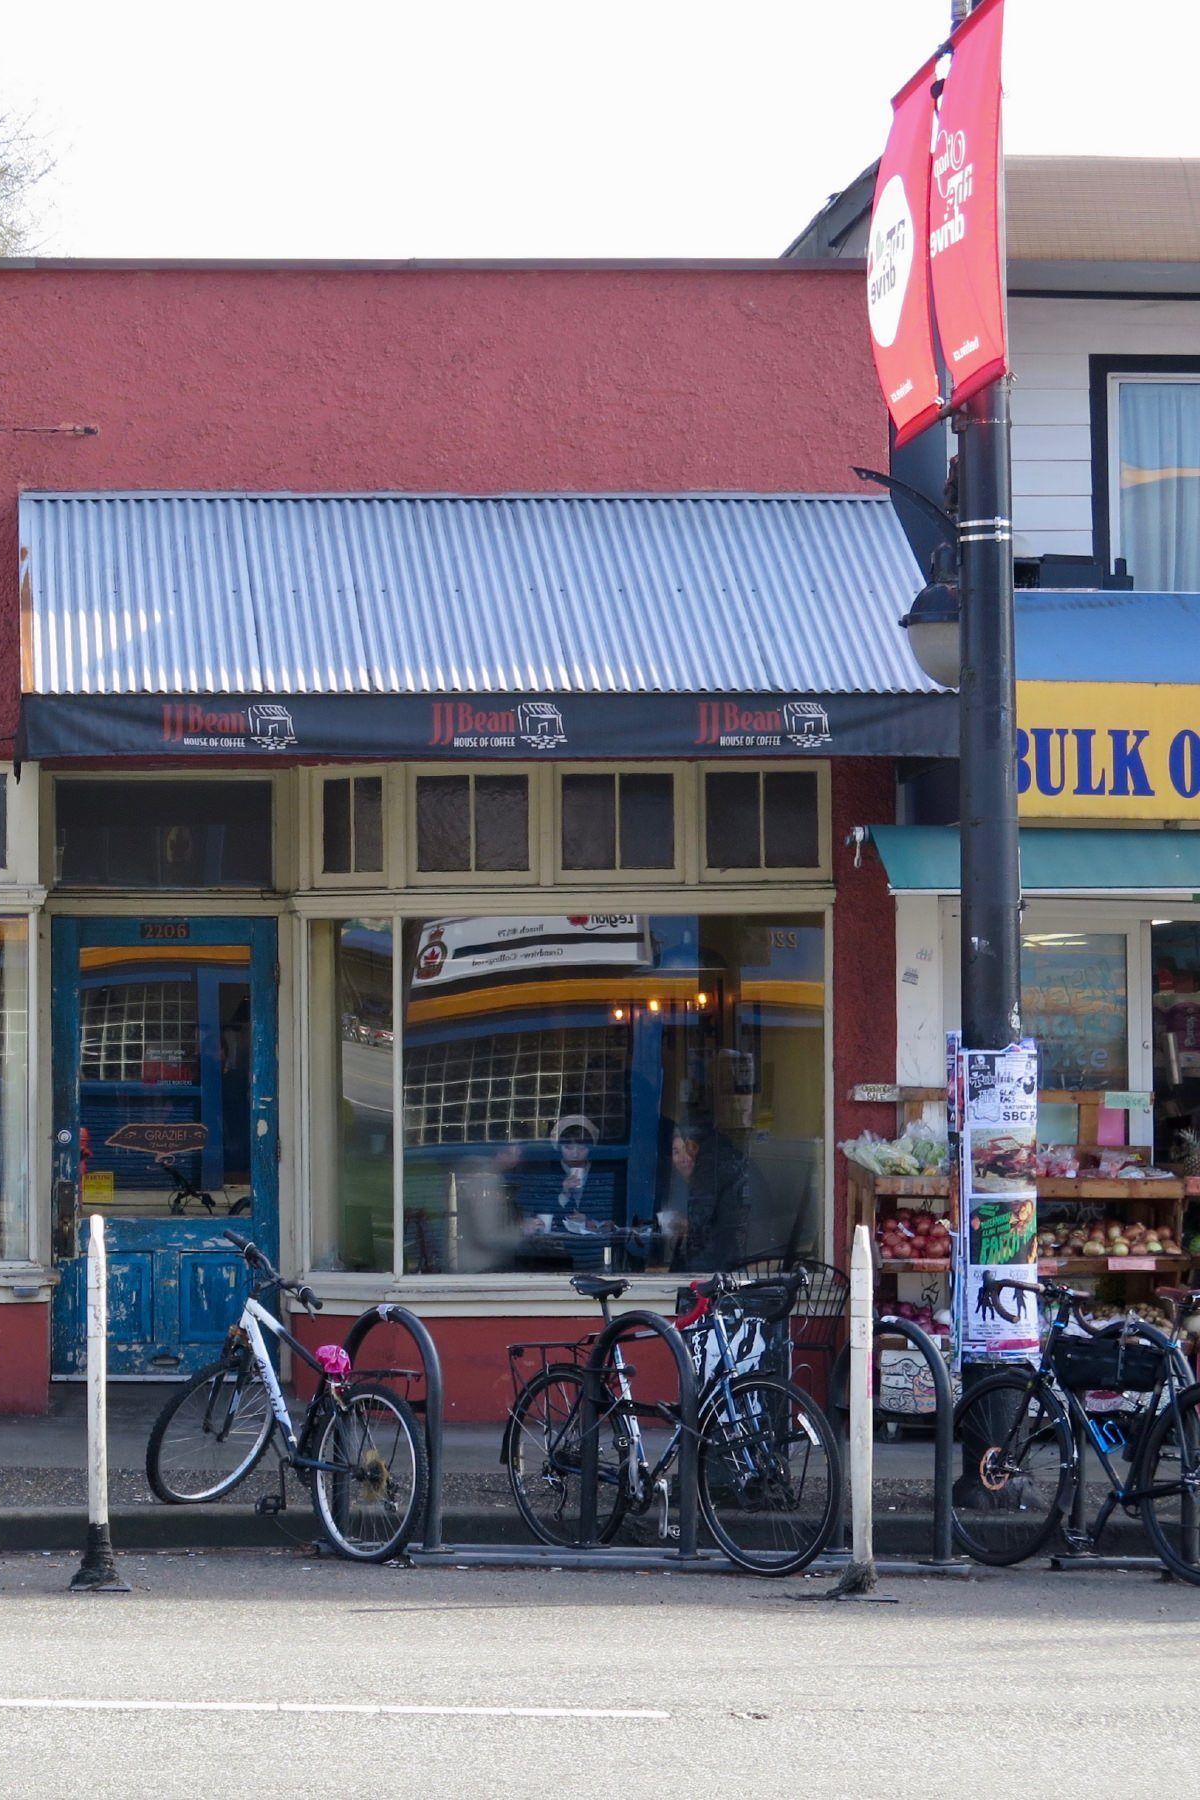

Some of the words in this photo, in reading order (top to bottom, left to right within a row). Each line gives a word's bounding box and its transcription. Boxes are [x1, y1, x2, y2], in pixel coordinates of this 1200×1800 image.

[183, 737, 208, 748] HOUSE
[209, 737, 219, 748] OF
[220, 737, 246, 748] COFFEE
[453, 736, 478, 748] HOUSE
[479, 736, 489, 748] OF
[490, 736, 516, 748] COFFEE
[719, 735, 744, 747] HOUSE
[745, 735, 755, 747] OF
[756, 735, 782, 747] COFFEE
[143, 923, 187, 939] 2206
[1002, 1111, 1027, 1121] SBC
[144, 1129, 187, 1141] GRAZIE!
